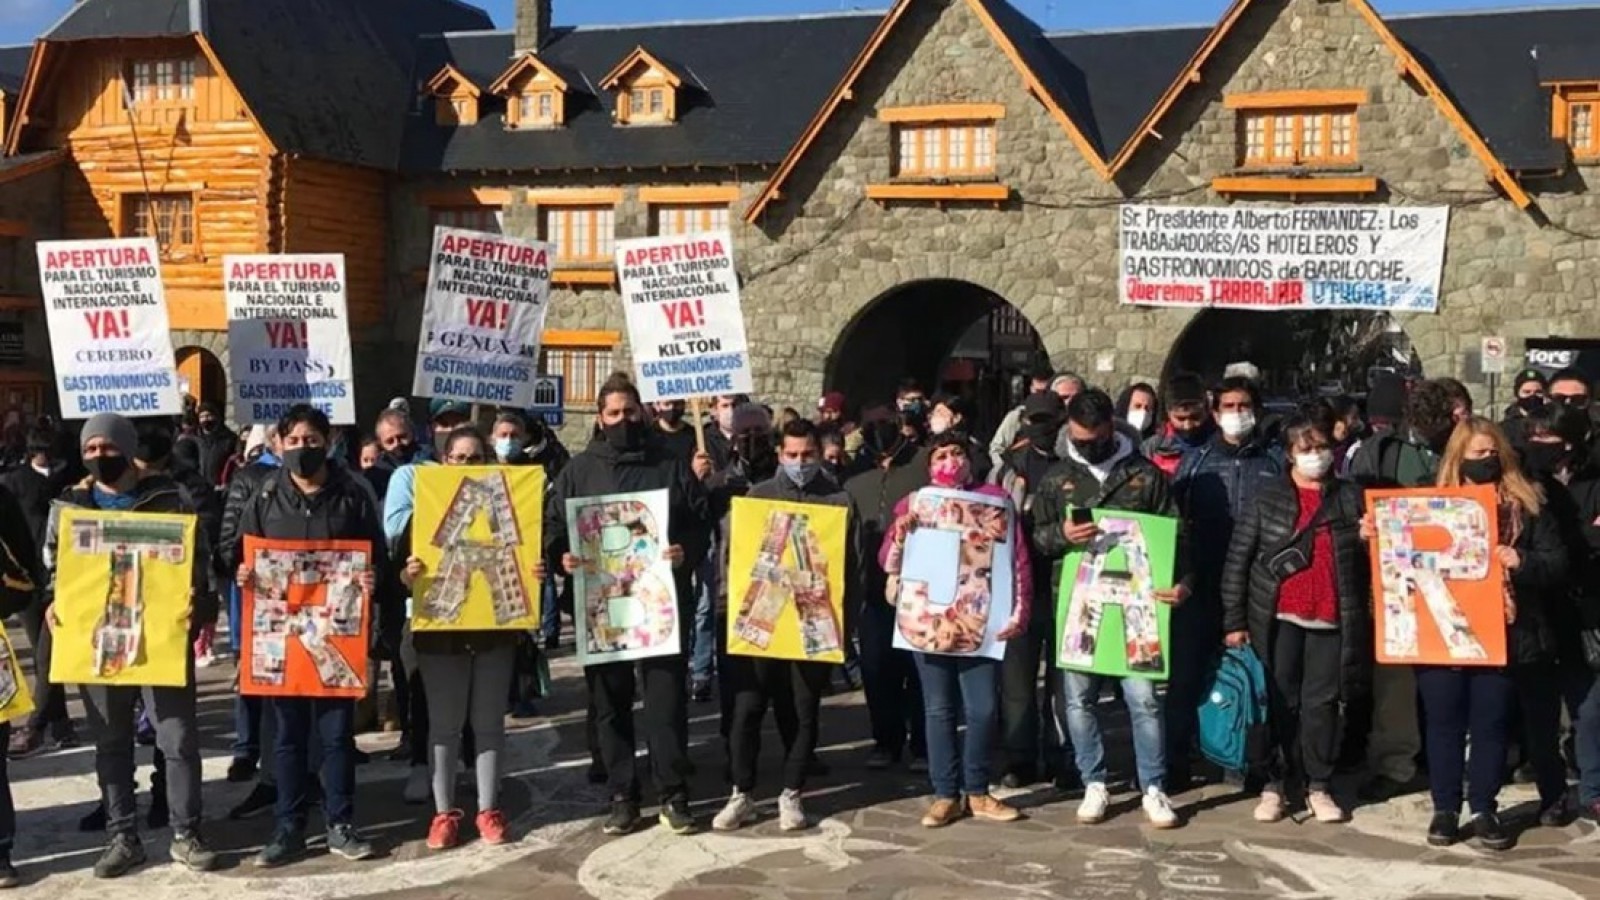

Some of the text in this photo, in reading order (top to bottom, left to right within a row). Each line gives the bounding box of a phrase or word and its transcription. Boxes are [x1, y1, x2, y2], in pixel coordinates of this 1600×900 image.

[1123, 207, 1141, 227] Sr.
[1293, 210, 1383, 231] FERNANDEZ:
[441, 235, 548, 267] APERTURA
[625, 239, 725, 266] APERTURA
[1267, 234, 1358, 254] HOTELEROS
[1370, 235, 1381, 254] Y
[46, 246, 151, 269] APERTURA
[437, 253, 548, 280] PARA EL TURISMO
[623, 257, 729, 279] PARA EL TURISMO
[44, 266, 157, 283] PARA EL TURISMO
[231, 262, 337, 280] APERTURA
[453, 270, 529, 290] NACIONAL E
[642, 270, 715, 290] NACIONAL E
[1125, 256, 1411, 284] GASTRONOMICOS de BARILOCHE,
[63, 280, 141, 295] NACIONAL E
[228, 281, 340, 293] PARA EL TURISMO
[437, 280, 540, 305] INTERNACIONAL
[631, 283, 730, 304] INTERNACIONAL
[1126, 278, 1204, 302] Queremos
[52, 293, 157, 309] INTERNACIONAL
[246, 294, 323, 306] NACIONAL E
[84, 309, 131, 339] YA!
[234, 306, 338, 319] INTERNACIONAL
[466, 298, 510, 330] YA!
[661, 299, 705, 329] YA!
[265, 321, 308, 349] YA!
[440, 331, 512, 355] GENUX
[75, 349, 153, 362] CEREBRO
[249, 359, 272, 373] BY
[433, 376, 514, 401] BARILOCHE
[656, 374, 733, 396] BARILOCHE
[78, 391, 160, 412] BARILOCHE
[576, 500, 676, 654] B
[1374, 497, 1489, 659] R
[1059, 517, 1165, 674] A
[252, 549, 366, 687] R
